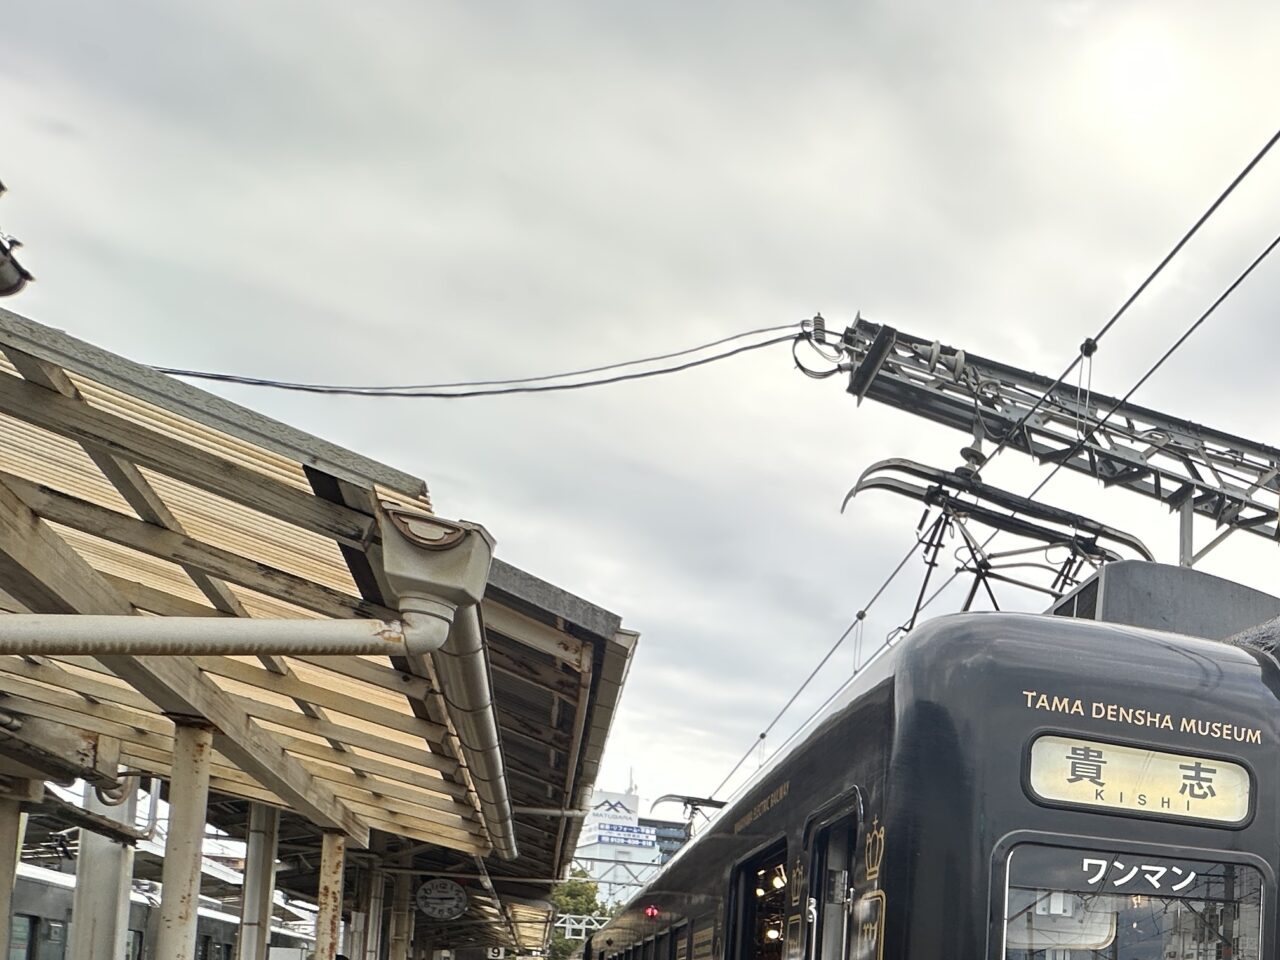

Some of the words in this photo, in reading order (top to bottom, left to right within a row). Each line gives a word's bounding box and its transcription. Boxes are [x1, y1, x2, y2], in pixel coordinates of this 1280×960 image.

[1022, 690, 1085, 716] TAMA
[1092, 702, 1174, 731] DENSHA
[1180, 717, 1262, 745] MUSEUM
[1095, 788, 1191, 811] KISHI
[1083, 858, 1196, 892] ワンマン
[491, 947, 500, 958] 9
